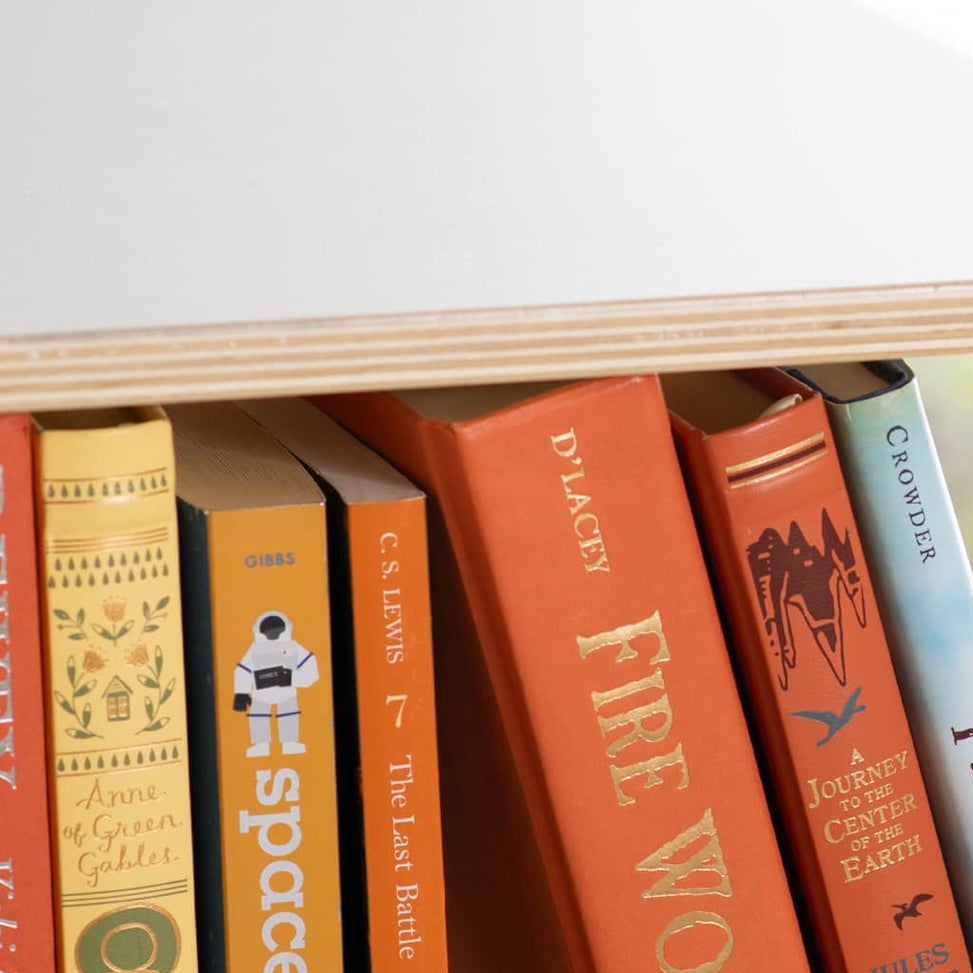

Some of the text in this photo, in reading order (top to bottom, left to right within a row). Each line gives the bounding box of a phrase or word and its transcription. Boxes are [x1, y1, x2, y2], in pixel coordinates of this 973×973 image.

[549, 428, 611, 575] D'LACEY
[885, 425, 937, 565] CROWDER
[244, 552, 295, 569] GIBBS
[379, 532, 404, 665] C. S. LEWIS
[385, 694, 408, 729] 7
[576, 609, 691, 806] FIRE
[807, 750, 909, 809] JOURNEY
[850, 748, 865, 765] A
[76, 777, 166, 810] Anne
[839, 783, 894, 812] TO THE
[63, 813, 182, 853] of Green
[824, 792, 918, 844] CENTER
[851, 823, 904, 852] OF THE
[78, 842, 180, 888] Gables
[389, 754, 422, 960] The Last Battle
[840, 834, 923, 883] EARTH
